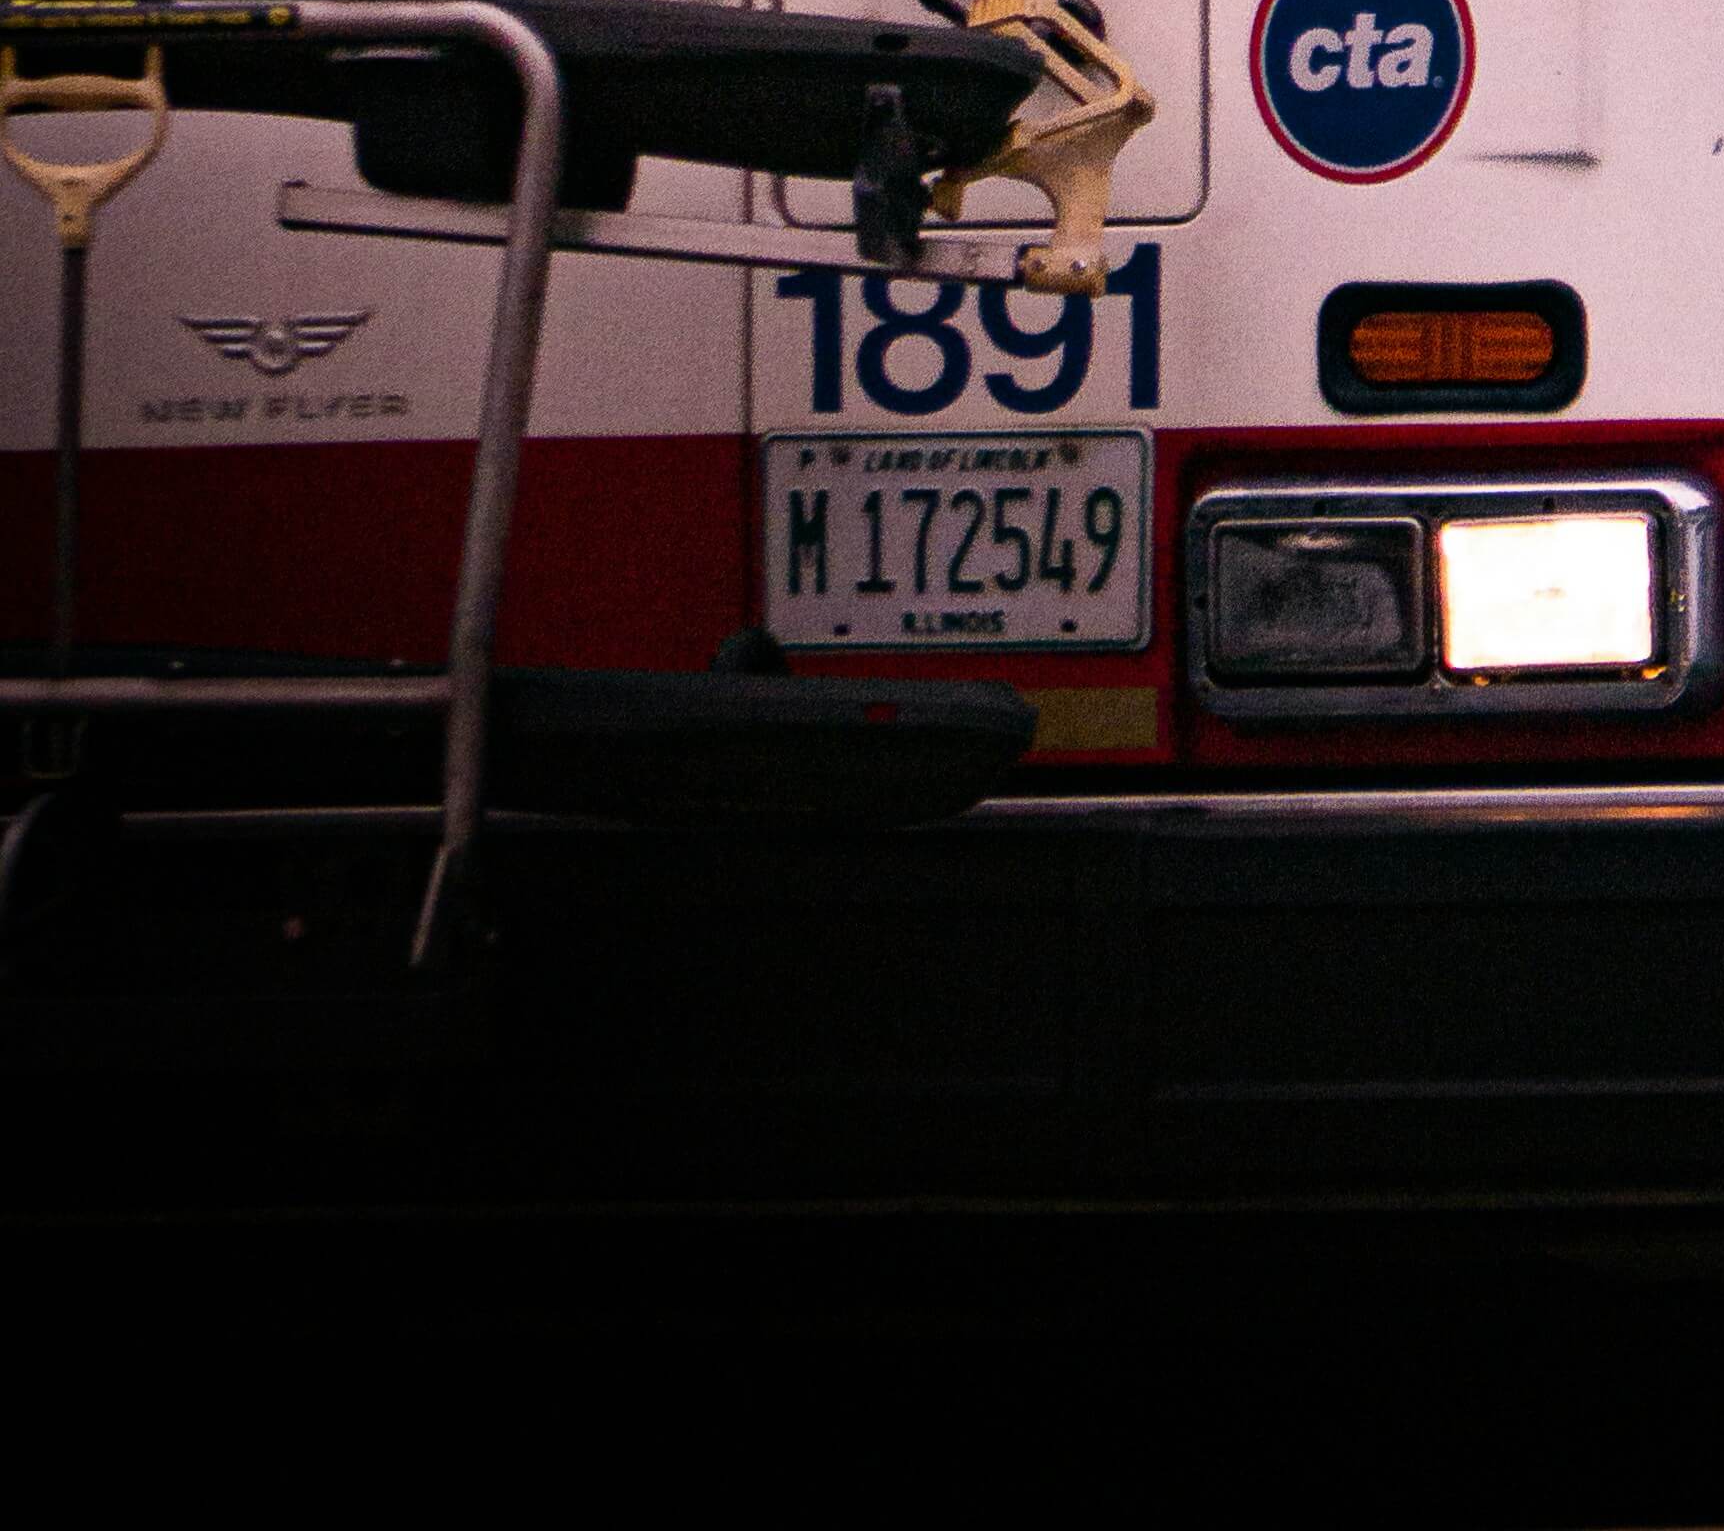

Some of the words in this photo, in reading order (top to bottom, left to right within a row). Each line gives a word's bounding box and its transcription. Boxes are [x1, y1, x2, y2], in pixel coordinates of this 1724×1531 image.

[1289, 13, 1433, 91] cta
[776, 243, 1160, 415] 1891
[142, 397, 246, 422] NEW
[264, 394, 409, 419] FLYER
[856, 487, 1123, 593] 172549
[902, 611, 1005, 632] ILLINOIS
